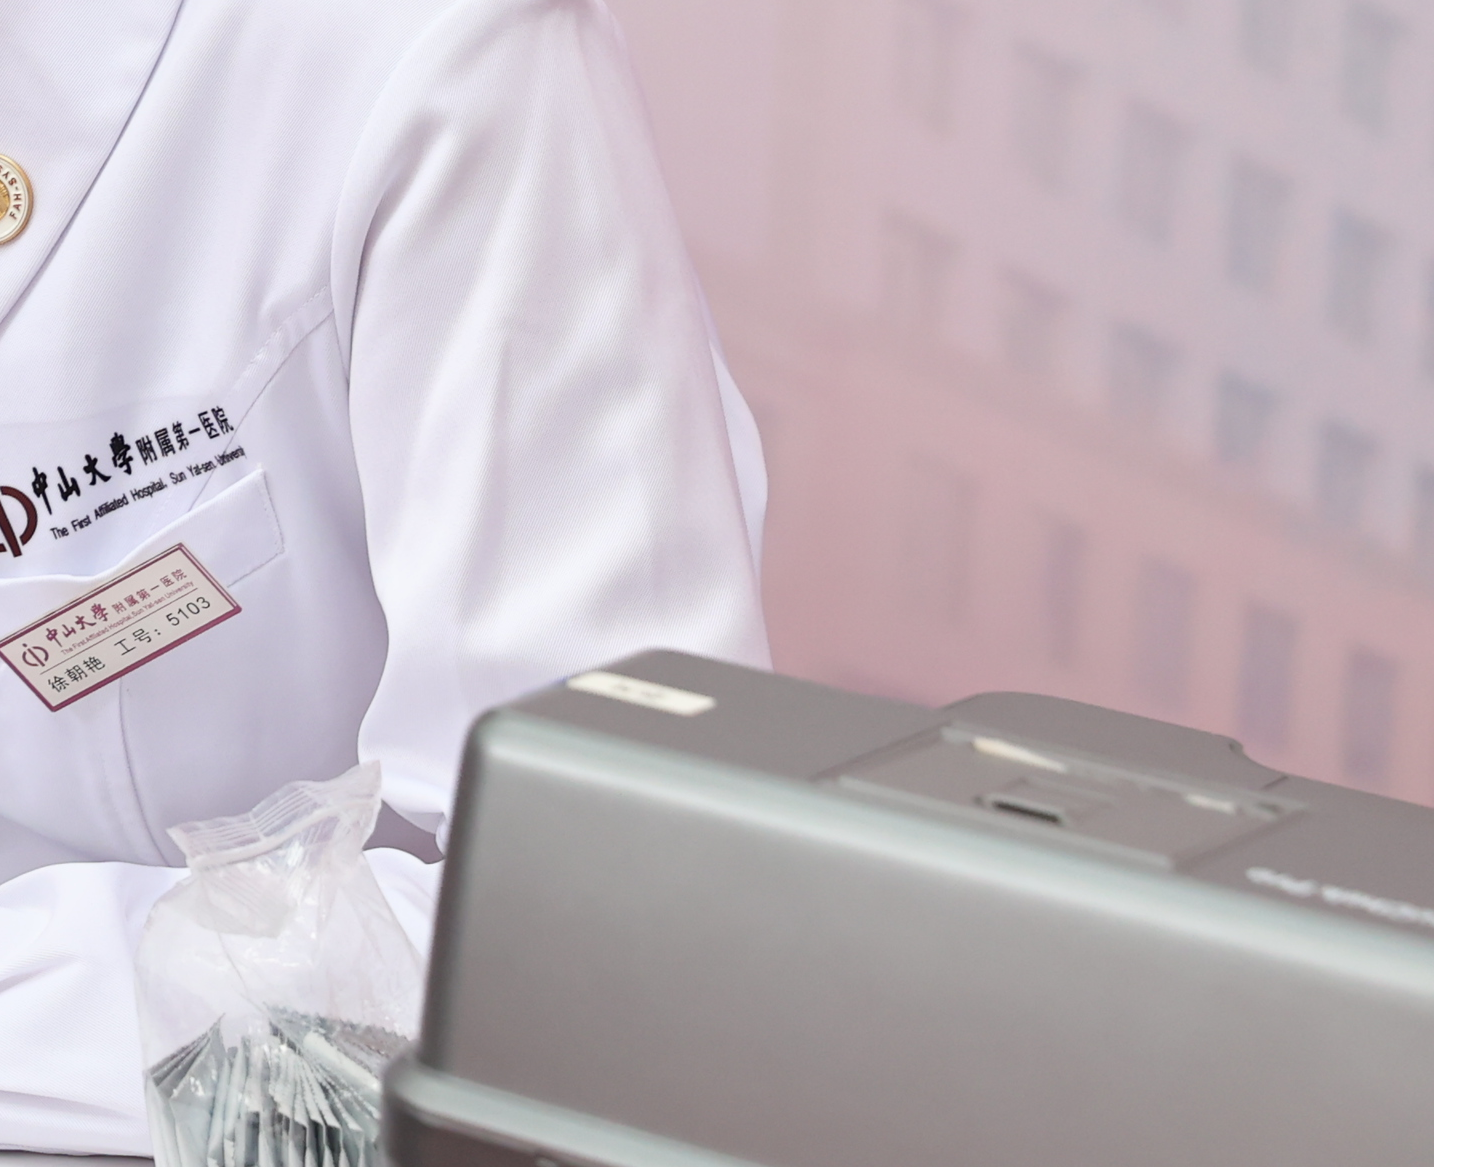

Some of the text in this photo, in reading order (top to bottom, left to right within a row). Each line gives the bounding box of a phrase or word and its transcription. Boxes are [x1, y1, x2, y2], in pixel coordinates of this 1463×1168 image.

[49, 526, 70, 540] The
[70, 514, 93, 532] First
[93, 493, 130, 521] Affiliated
[168, 471, 188, 485] Sun
